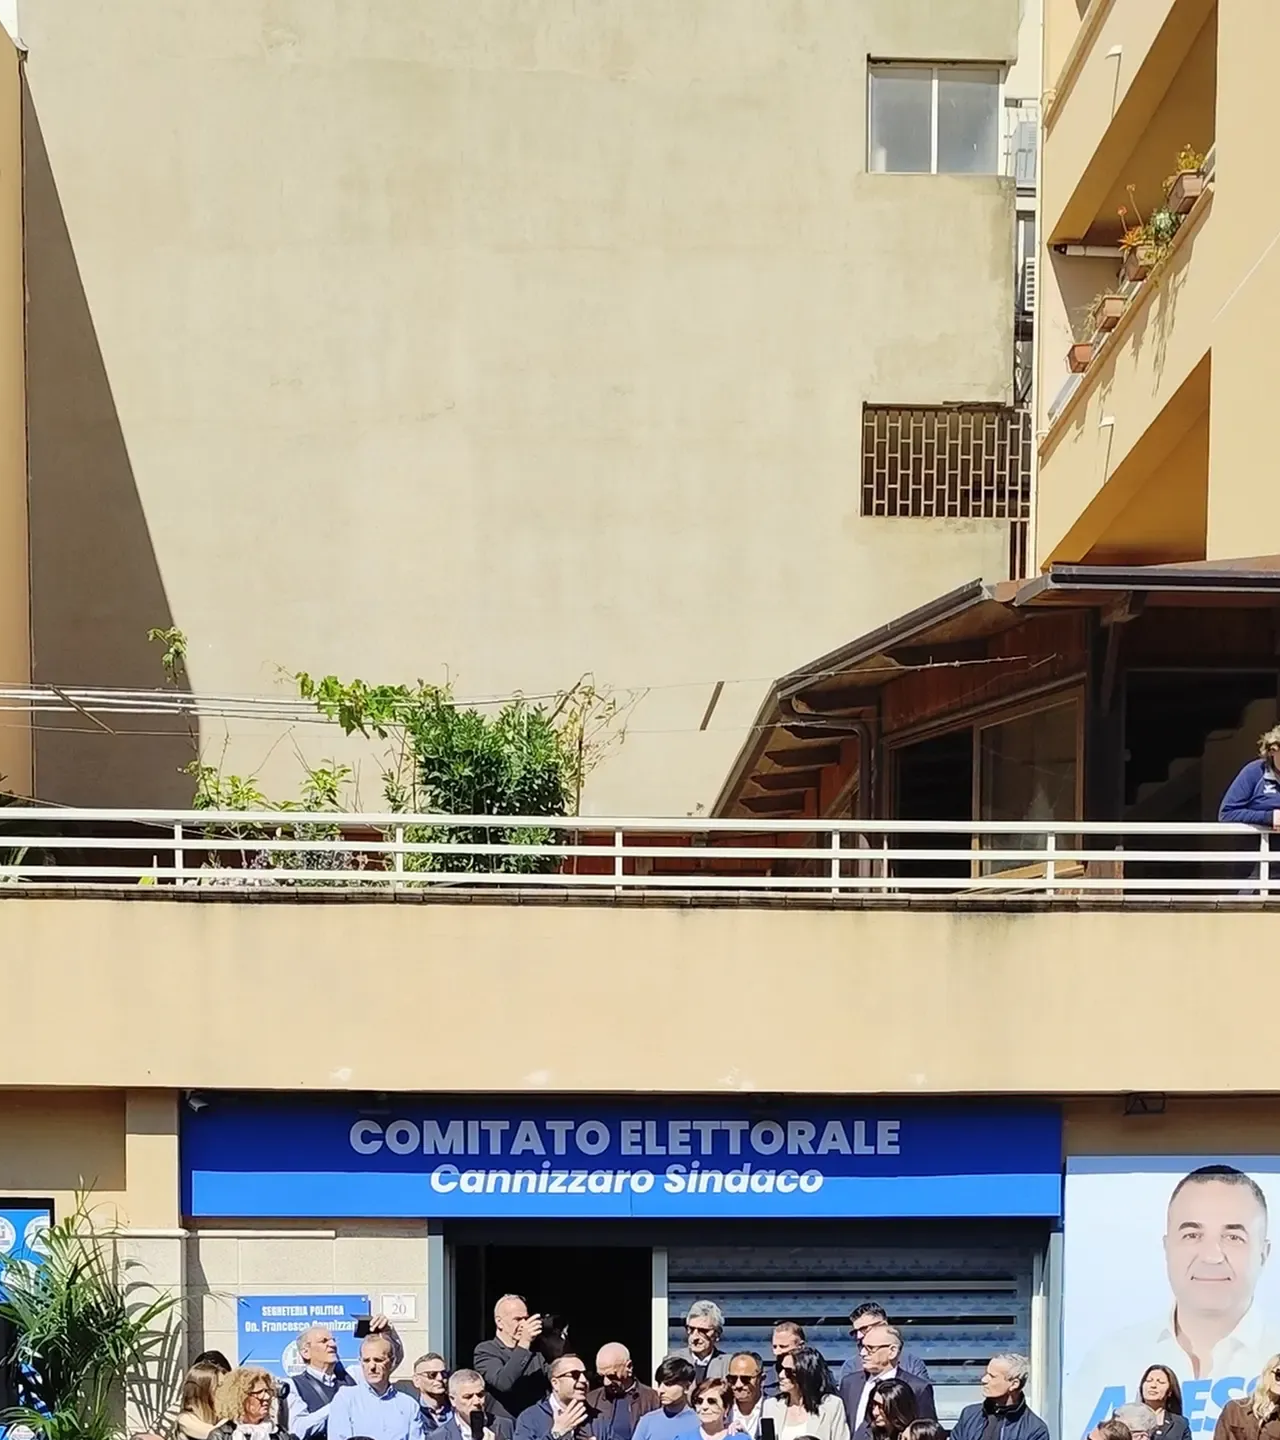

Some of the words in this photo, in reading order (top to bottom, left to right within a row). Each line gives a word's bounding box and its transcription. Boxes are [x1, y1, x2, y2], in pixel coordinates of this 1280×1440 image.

[349, 1119, 611, 1156] COMITATO
[620, 1119, 901, 1156] ELETTORALE
[430, 1160, 655, 1194] Cannizzaro
[663, 1160, 824, 1194] Sindaco
[310, 1304, 345, 1316] POLITICA
[391, 1302, 407, 1315] 20
